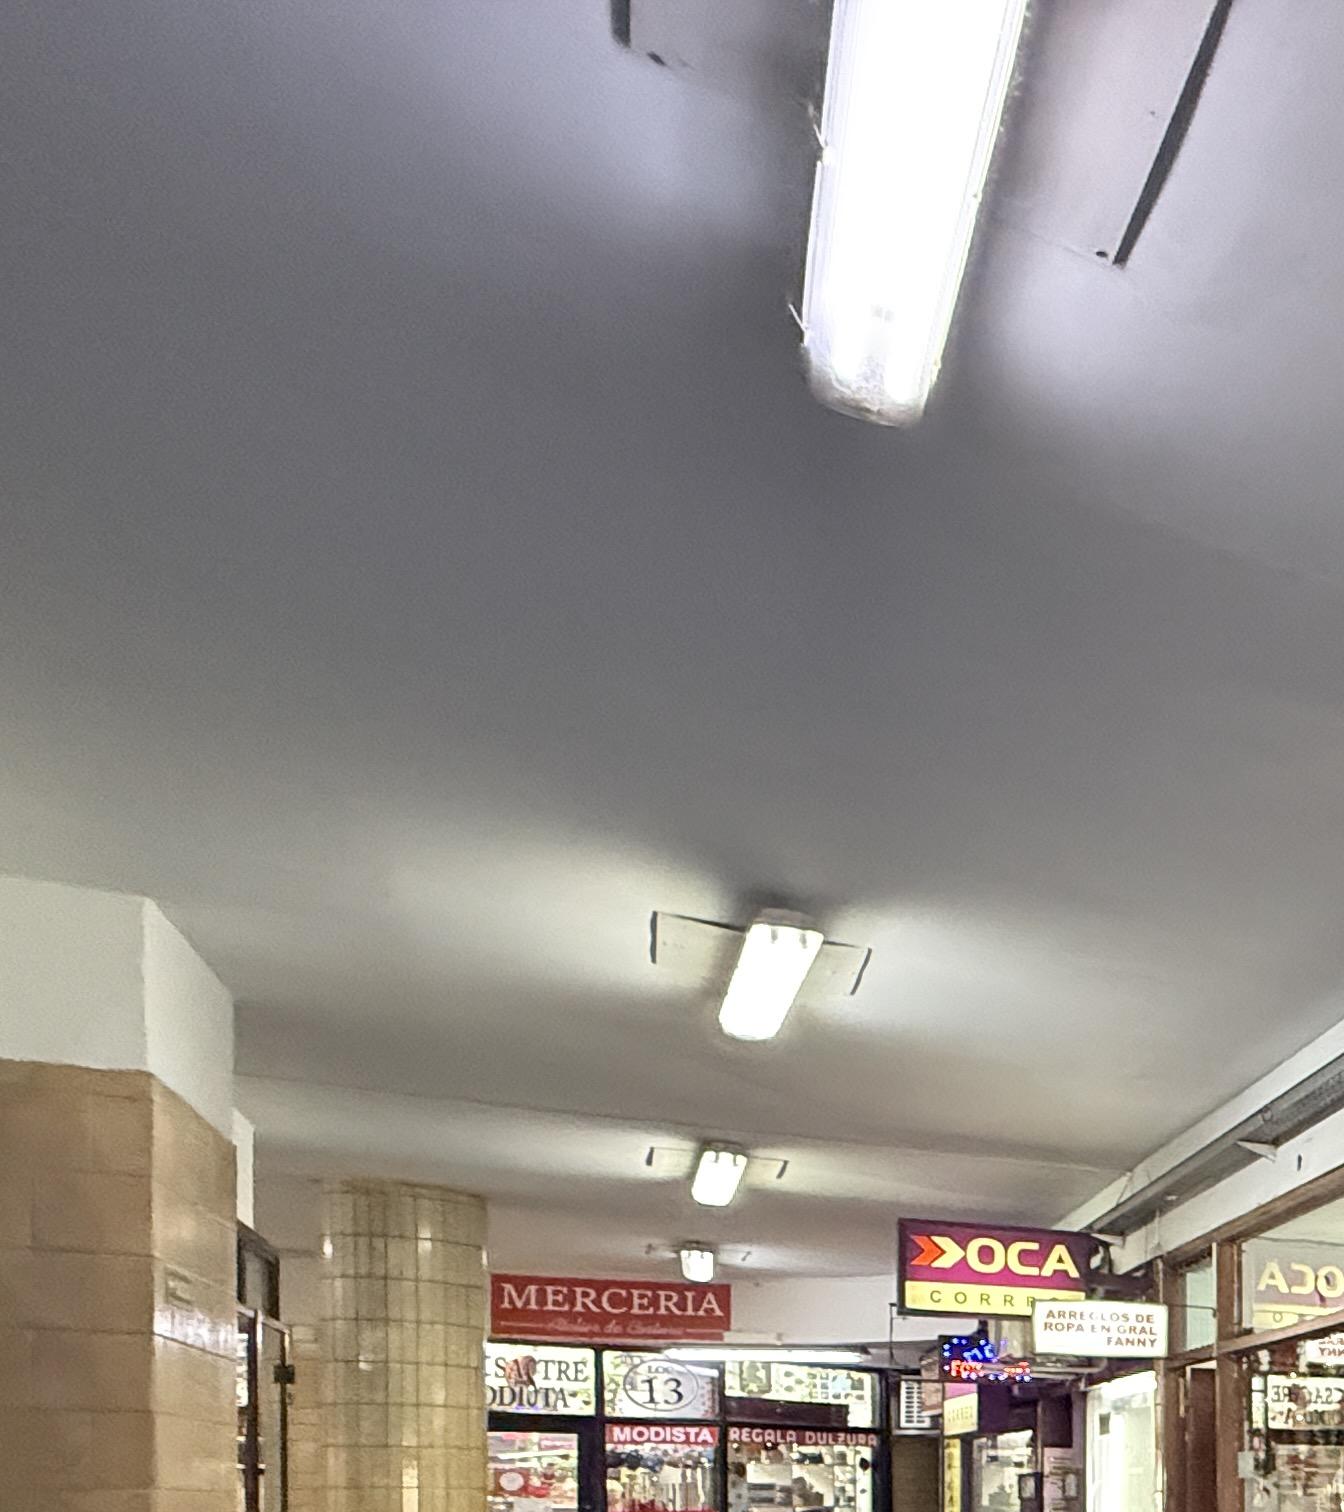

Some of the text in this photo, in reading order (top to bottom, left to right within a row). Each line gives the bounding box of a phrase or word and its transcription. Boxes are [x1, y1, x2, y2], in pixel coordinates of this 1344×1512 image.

[966, 1237, 1080, 1278] OCA
[501, 1283, 724, 1316] MERCERIA
[1136, 1314, 1155, 1324] DE
[1043, 1322, 1085, 1333] ROPA
[1107, 1337, 1158, 1348] FANNY
[641, 1378, 683, 1406] 13
[613, 1427, 713, 1443] MODISTA
[730, 1428, 797, 1444] REGALA
